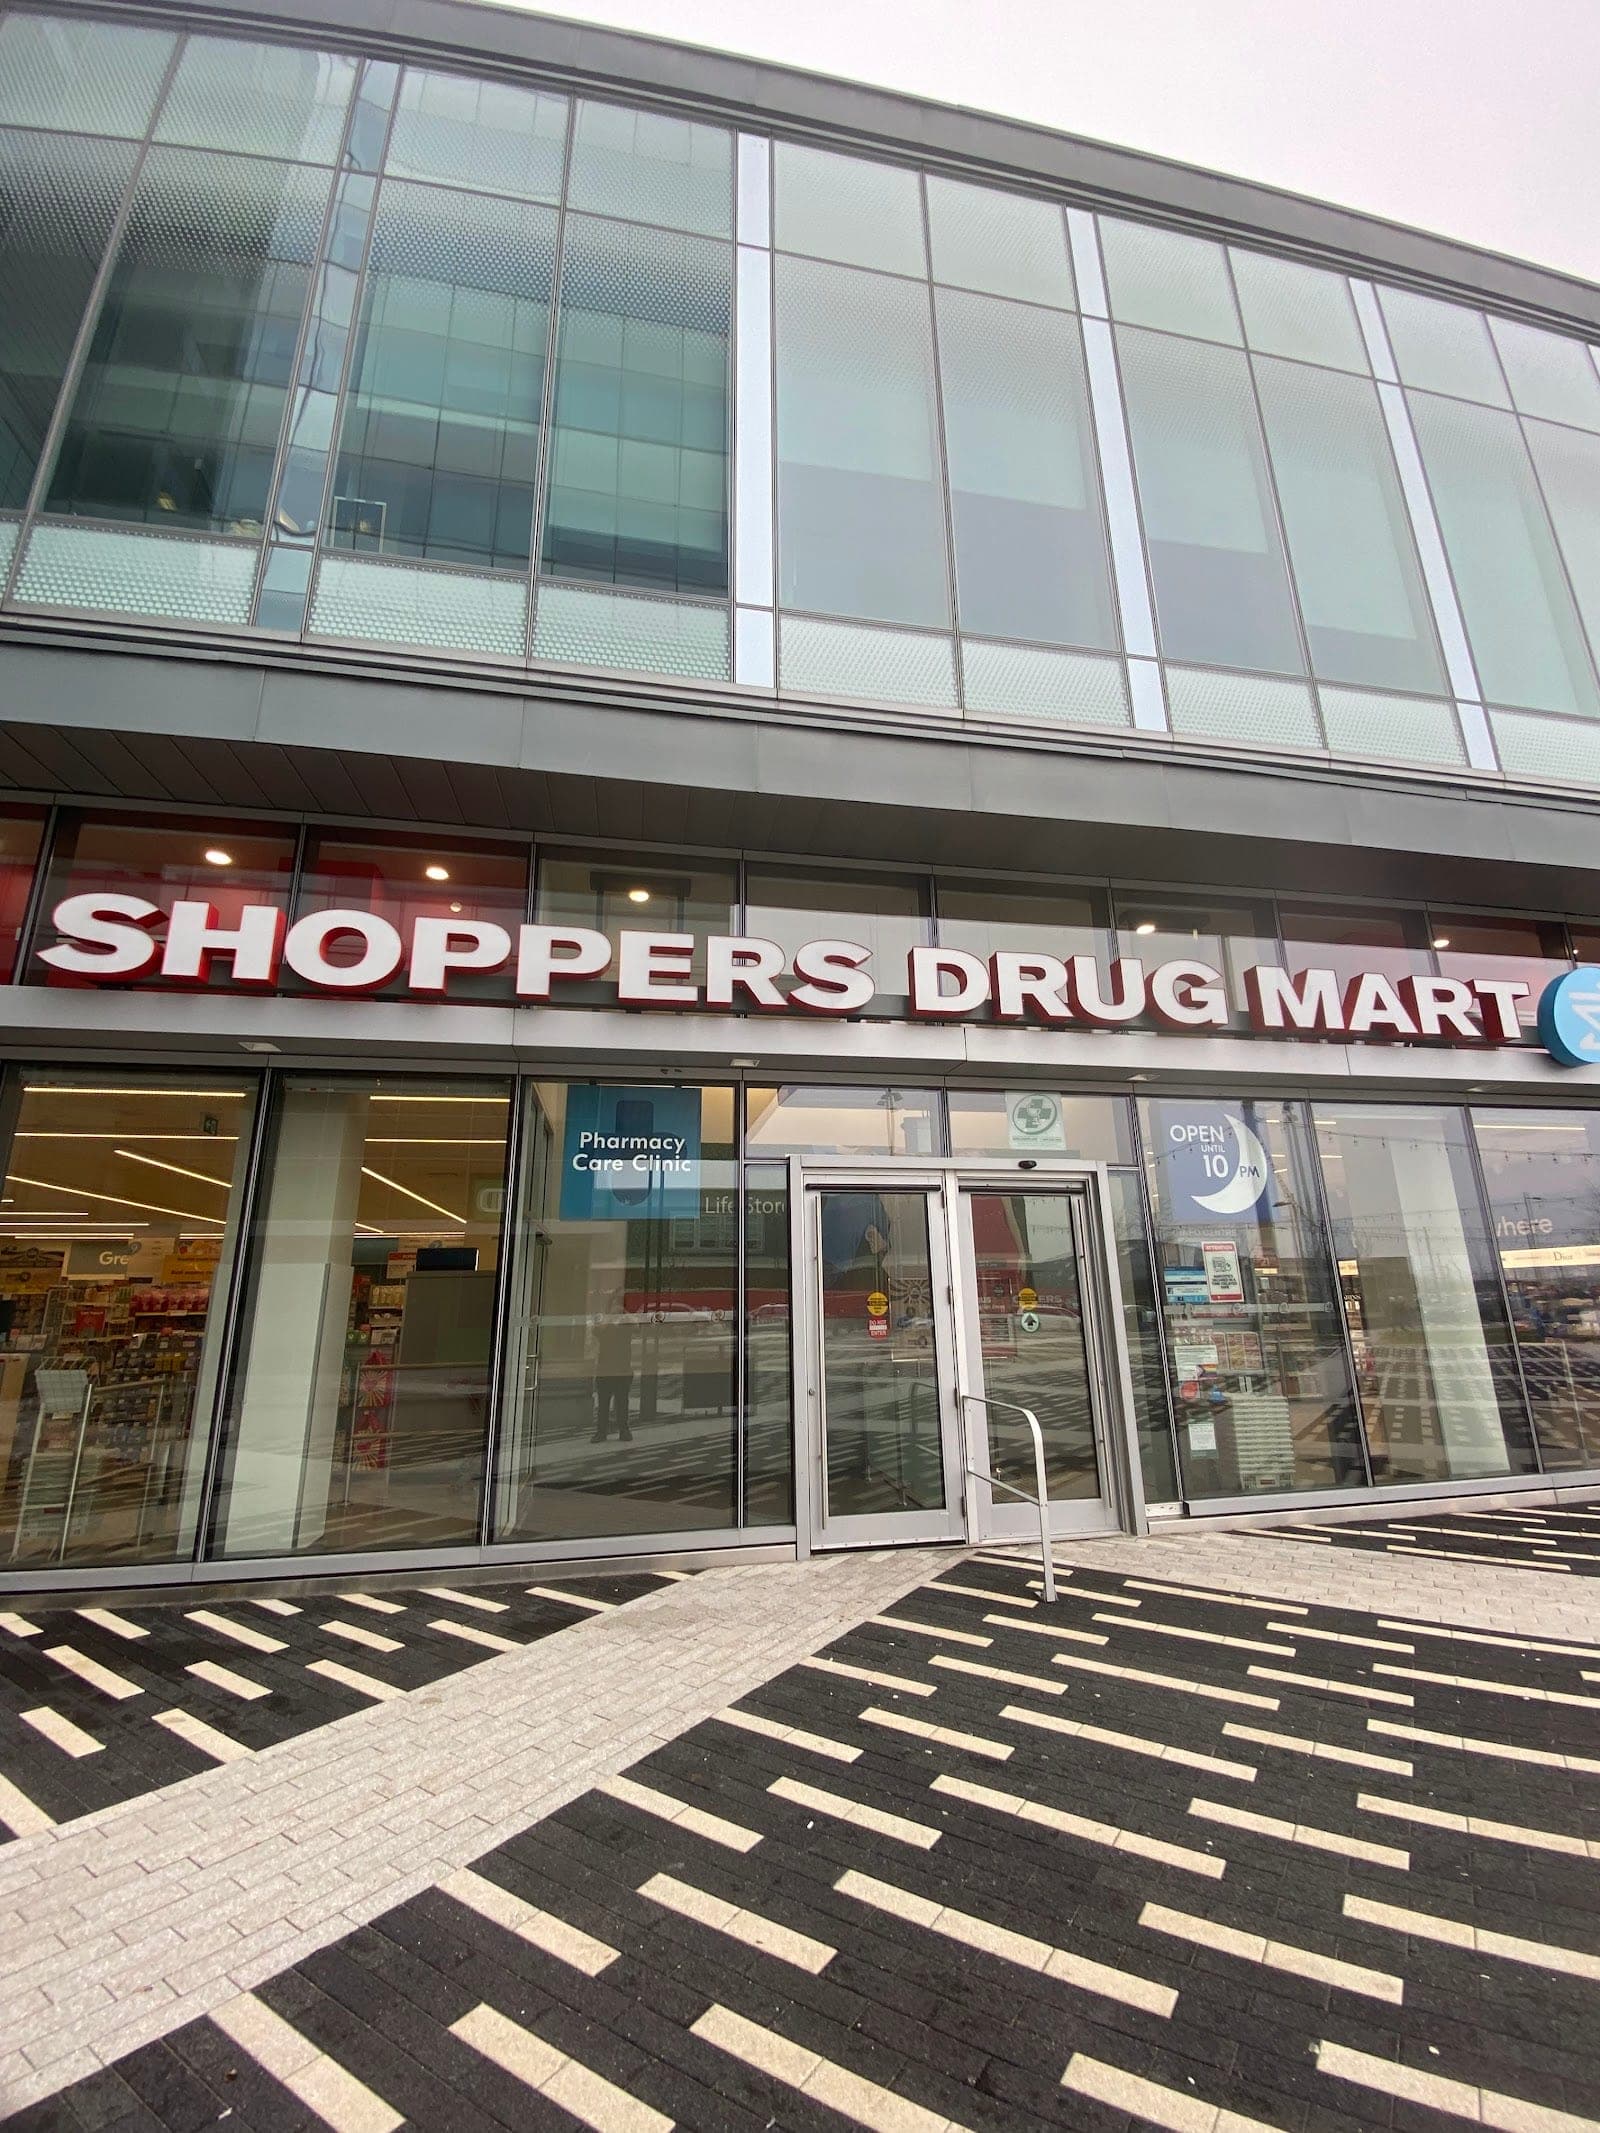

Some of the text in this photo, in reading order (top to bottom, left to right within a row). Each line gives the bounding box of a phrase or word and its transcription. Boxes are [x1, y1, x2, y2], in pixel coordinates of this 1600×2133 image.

[36, 891, 1531, 1042] SHOPPERS DRUG MART
[579, 1131, 686, 1153] Pharmacy
[1169, 1124, 1225, 1143] OPEN
[1200, 1144, 1226, 1153] UNTIL
[572, 1153, 692, 1172] Care Clinic
[1203, 1154, 1229, 1178] 10
[1239, 1165, 1260, 1178] PM
[748, 1196, 785, 1214] Stor
